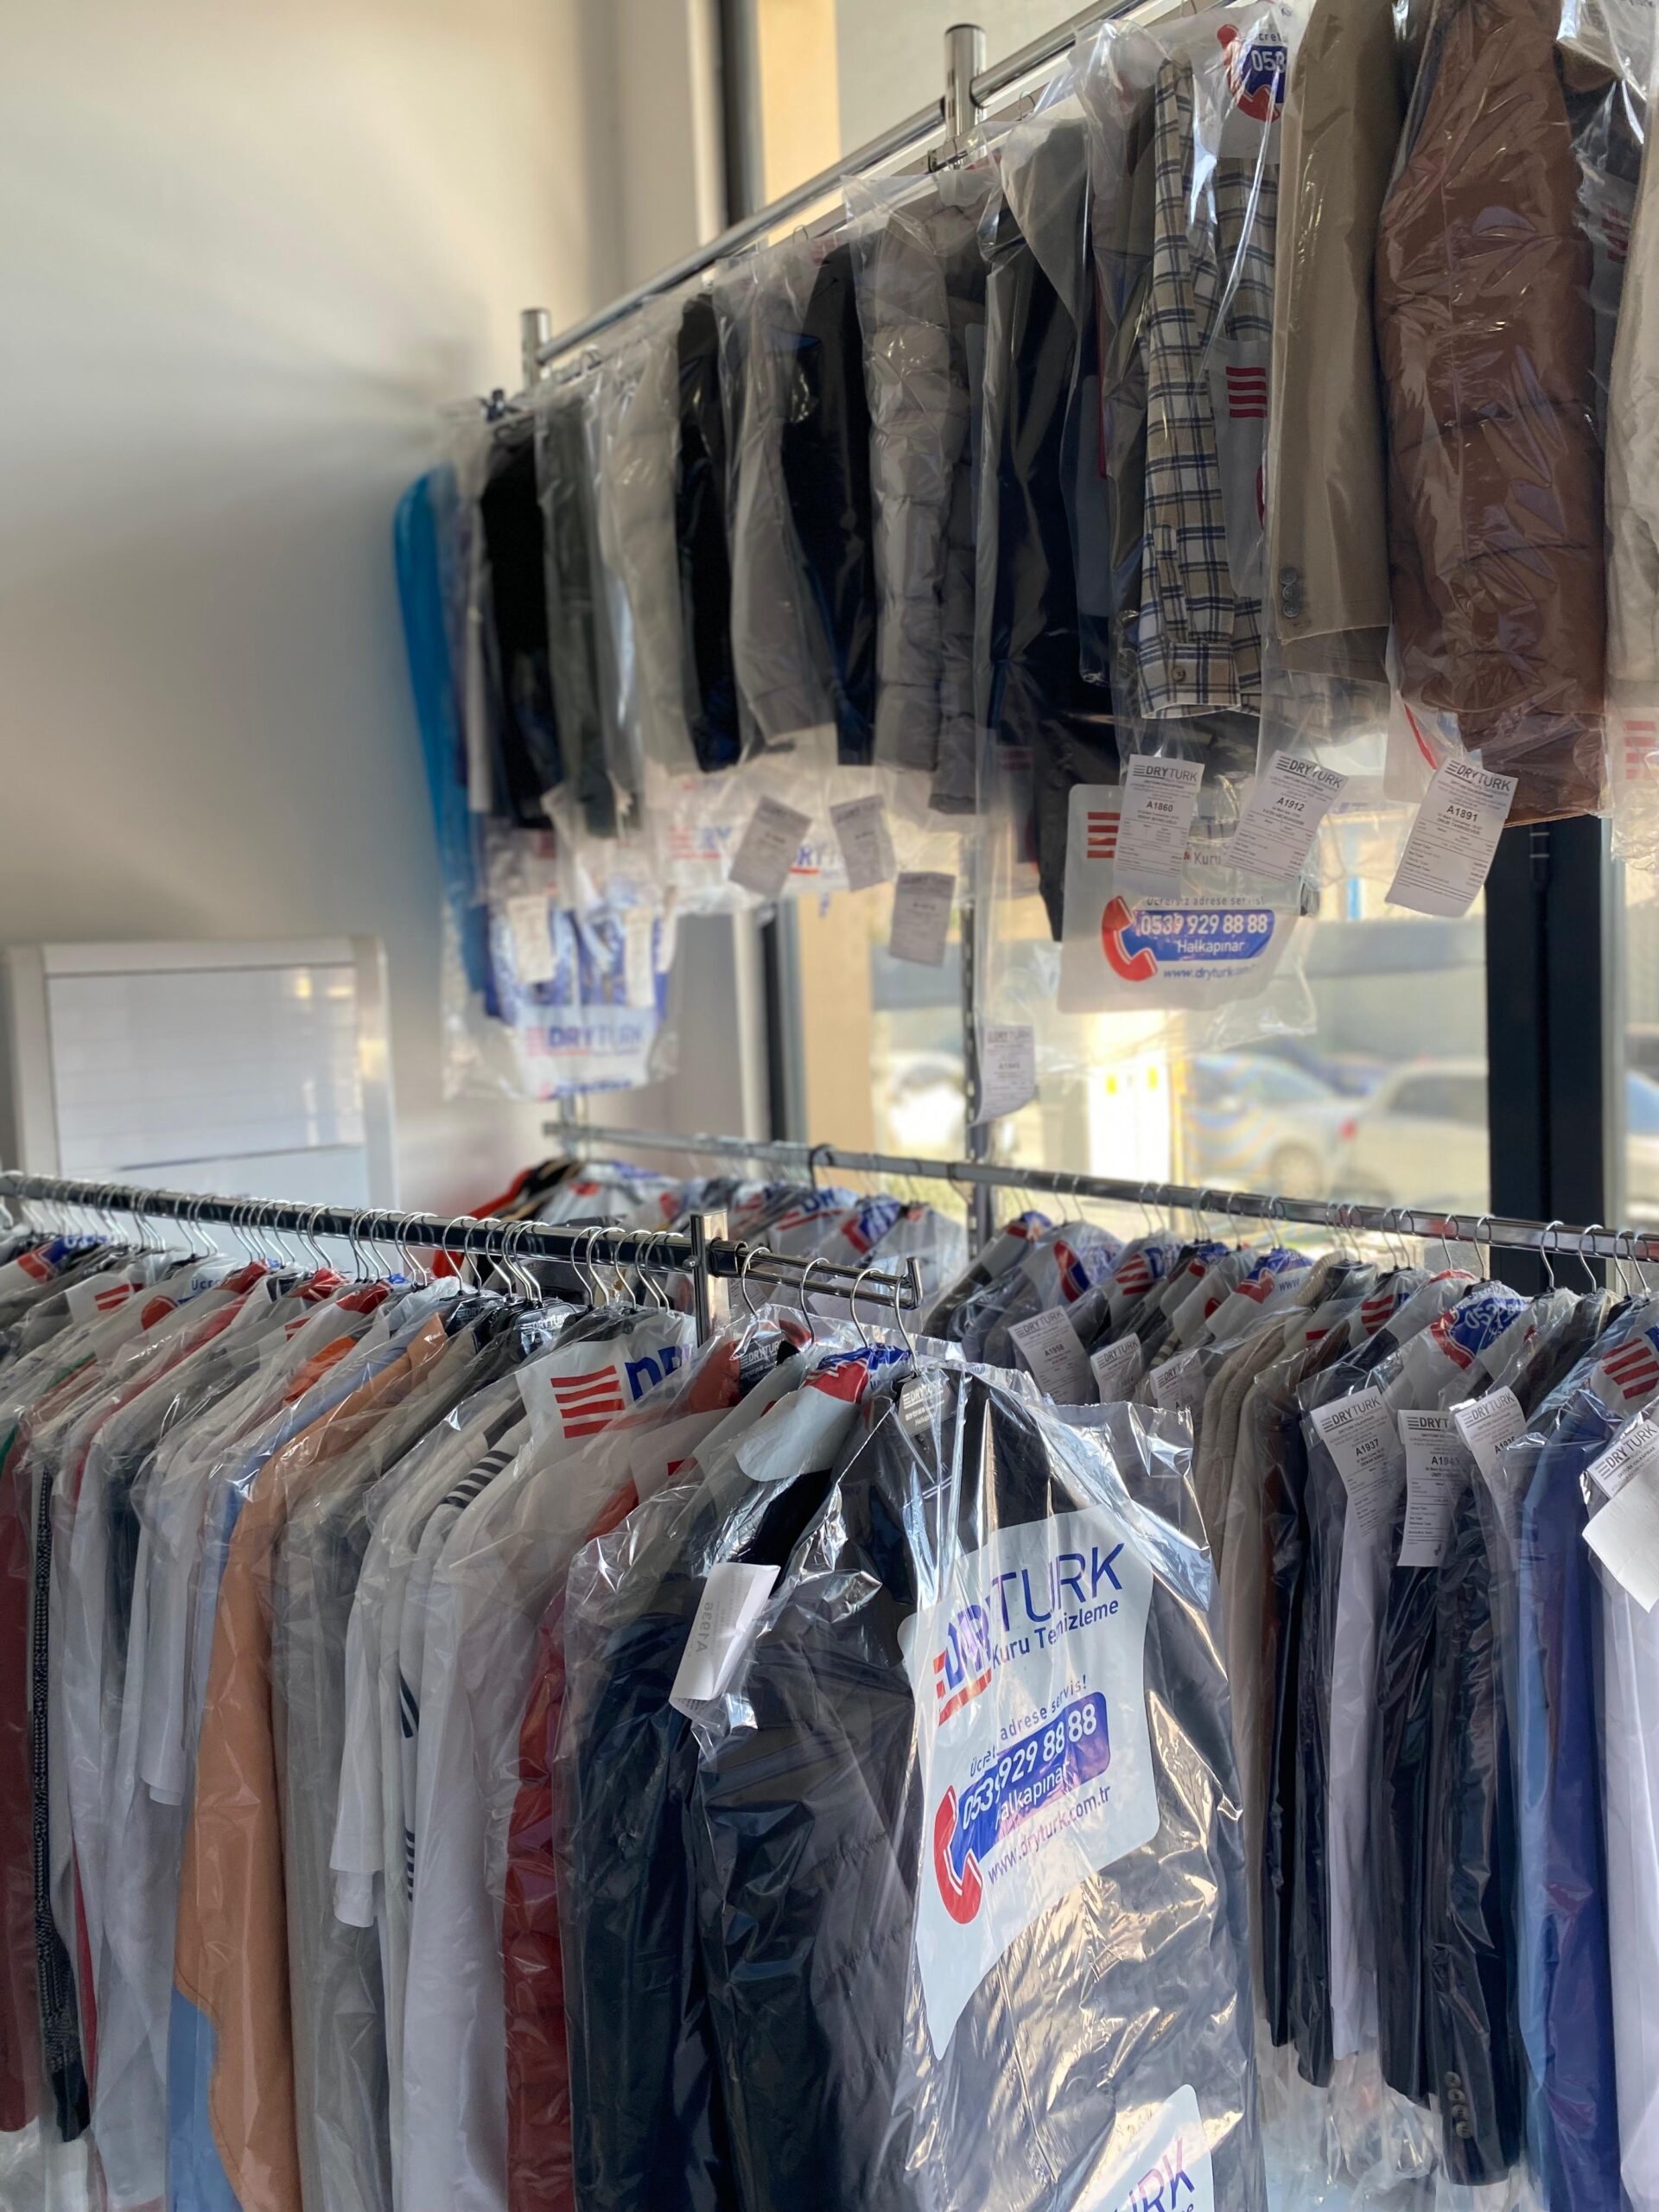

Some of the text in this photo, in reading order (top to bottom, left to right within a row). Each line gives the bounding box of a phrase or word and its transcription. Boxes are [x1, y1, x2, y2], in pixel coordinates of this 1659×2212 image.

[1145, 766, 1198, 782] DRYTURK
[1456, 764, 1511, 791] DRYTURK
[1146, 801, 1173, 812] A1860
[1276, 797, 1306, 811] A1912
[1446, 804, 1478, 822] A1891
[1192, 895, 1228, 906] adrese
[1140, 913, 1268, 936] 0539 929 88 88
[1022, 1311, 1064, 1333] DRYTURK
[1103, 1338, 1139, 1363] DRYTURK
[1332, 1395, 1382, 1425] DRYTURK
[1471, 1393, 1515, 1420] DRYTURK
[1356, 1439, 1380, 1456] A1937
[1605, 1425, 1657, 1468] DRYTURK
[946, 1542, 1125, 1690] DRTURK
[993, 1637, 1031, 1669] Kuru
[1001, 1707, 1048, 1741] adrese
[1052, 1674, 1087, 1713] servis!
[997, 1740, 1039, 1789] 929
[1042, 1721, 1065, 1763] 88
[1067, 1702, 1097, 1744] 88
